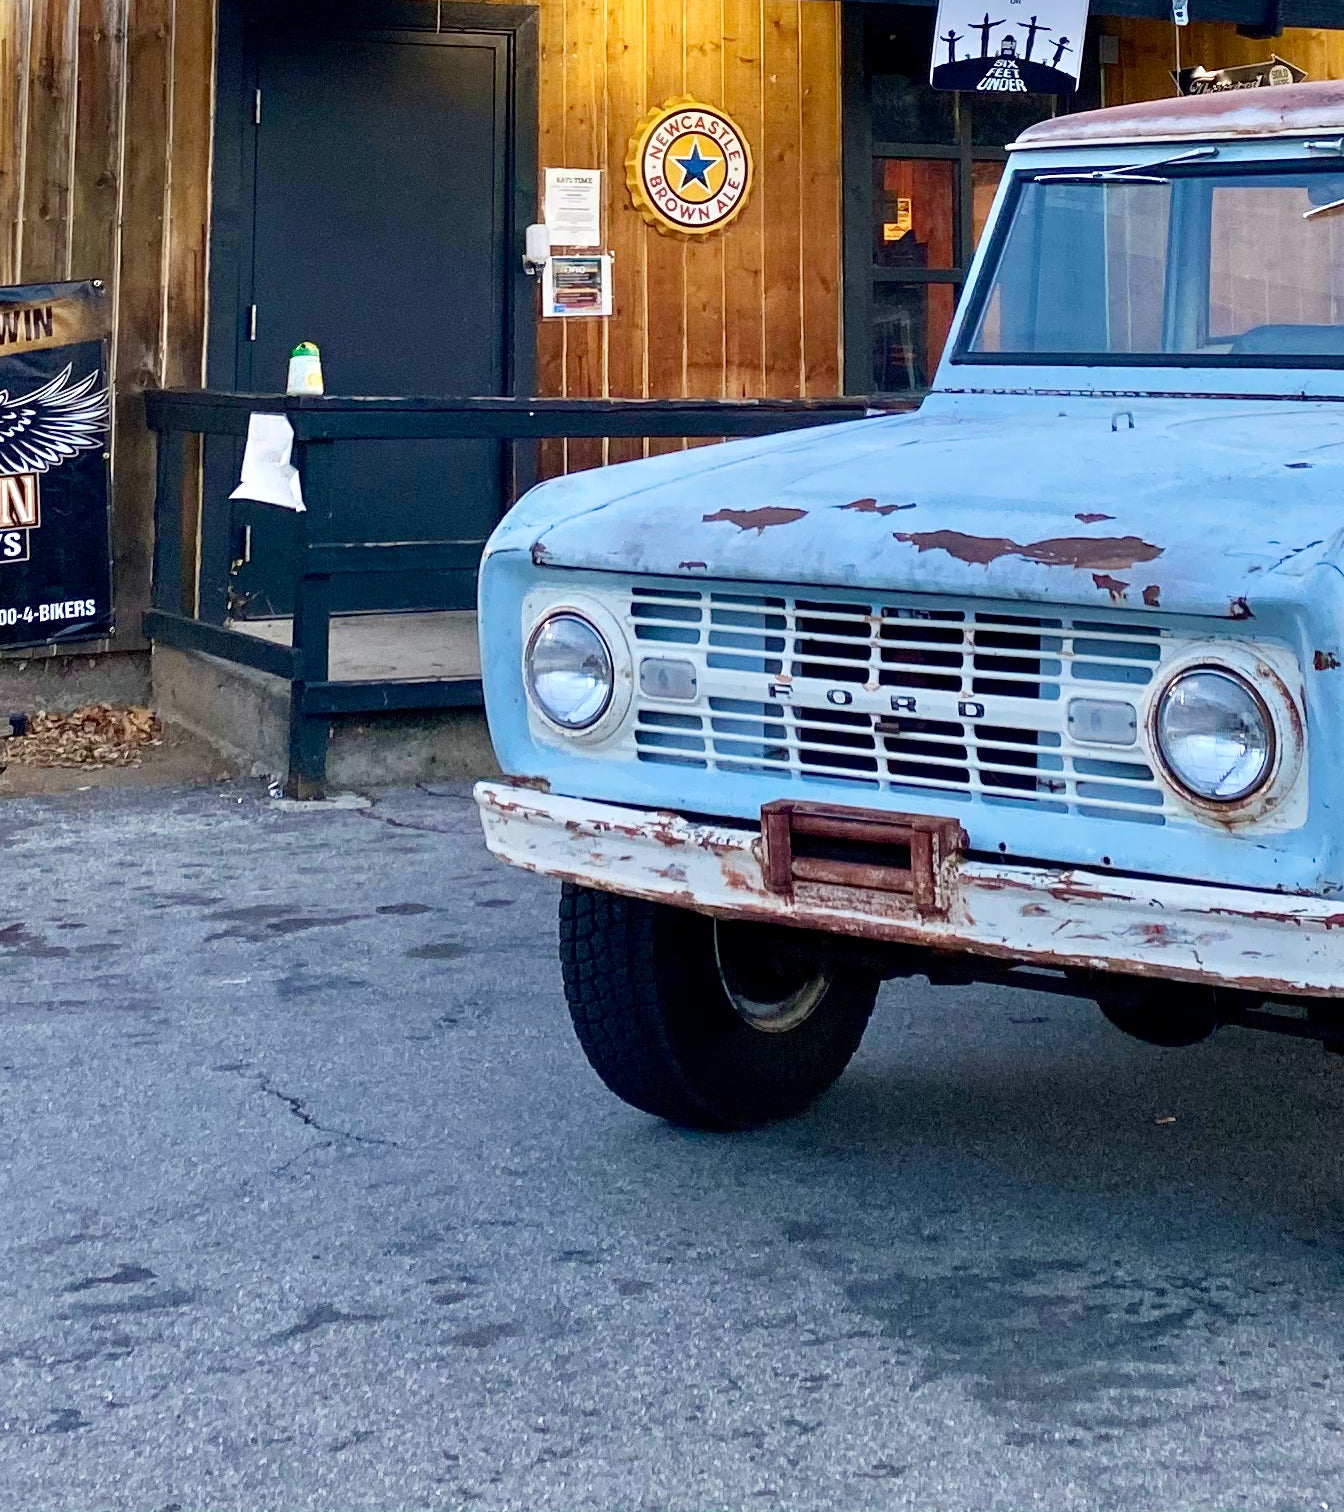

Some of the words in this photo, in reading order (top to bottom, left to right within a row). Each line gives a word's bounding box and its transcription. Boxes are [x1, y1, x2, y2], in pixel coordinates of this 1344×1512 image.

[985, 67, 1020, 79] FEET
[993, 59, 1019, 69] SIX
[976, 77, 1028, 93] UNDER
[649, 115, 741, 162] NEWCASTLE
[649, 175, 711, 221] BROWN
[716, 177, 741, 214] ALE
[768, 682, 985, 718] FORD
